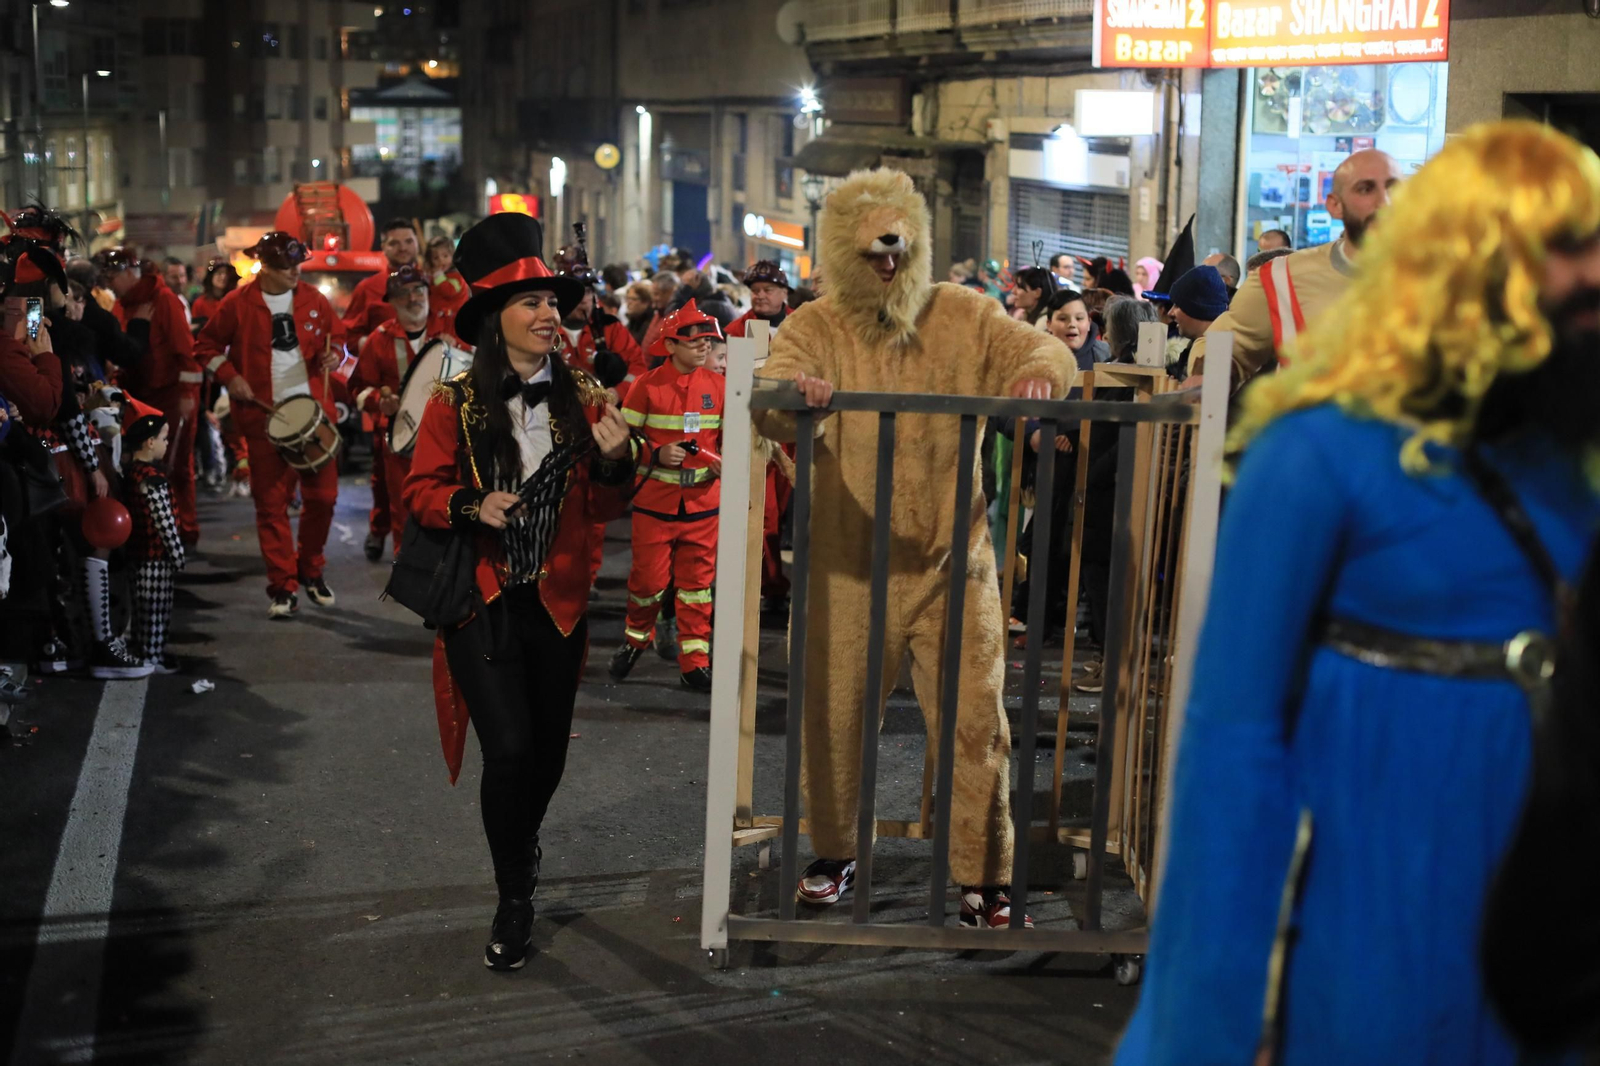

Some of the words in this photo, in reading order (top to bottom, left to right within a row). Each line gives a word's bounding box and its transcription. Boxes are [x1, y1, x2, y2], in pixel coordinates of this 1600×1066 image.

[1187, 0, 1205, 28] 2
[1217, 2, 1282, 38] Bazar
[1289, 0, 1417, 35] SHANGHAI
[1115, 33, 1192, 62] Bazar
